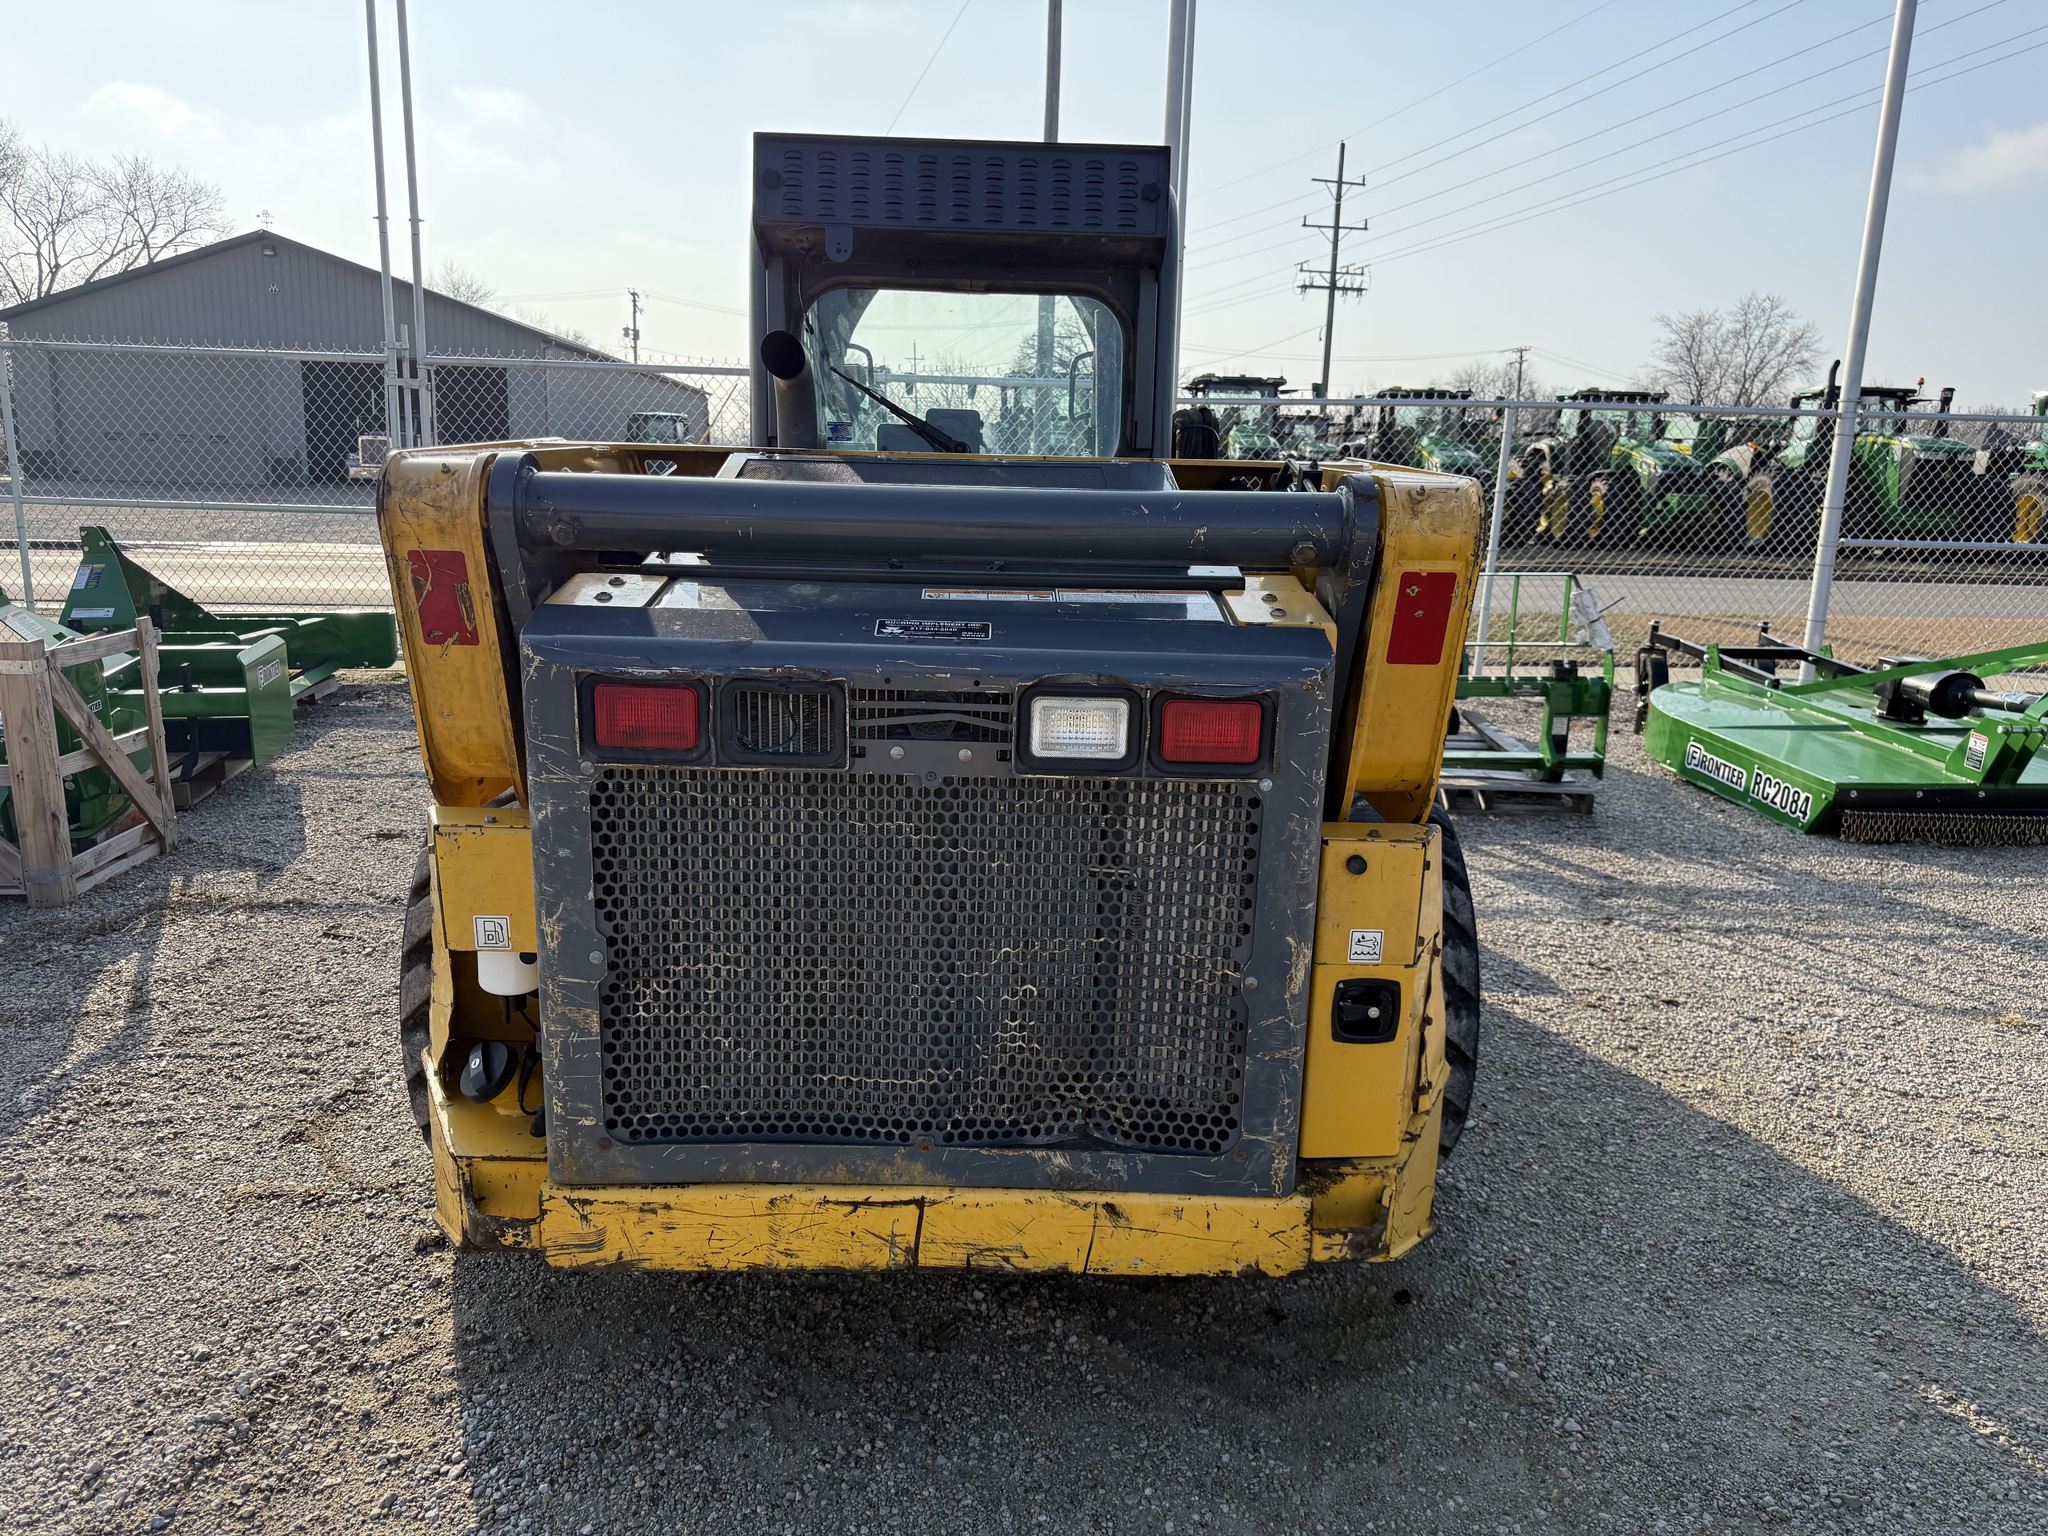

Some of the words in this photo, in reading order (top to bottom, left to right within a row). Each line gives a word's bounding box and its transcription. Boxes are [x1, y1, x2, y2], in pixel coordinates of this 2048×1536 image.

[1686, 743, 1745, 789] FRONTIER
[1751, 770, 1811, 821] RC2084
[487, 933, 494, 941] D
